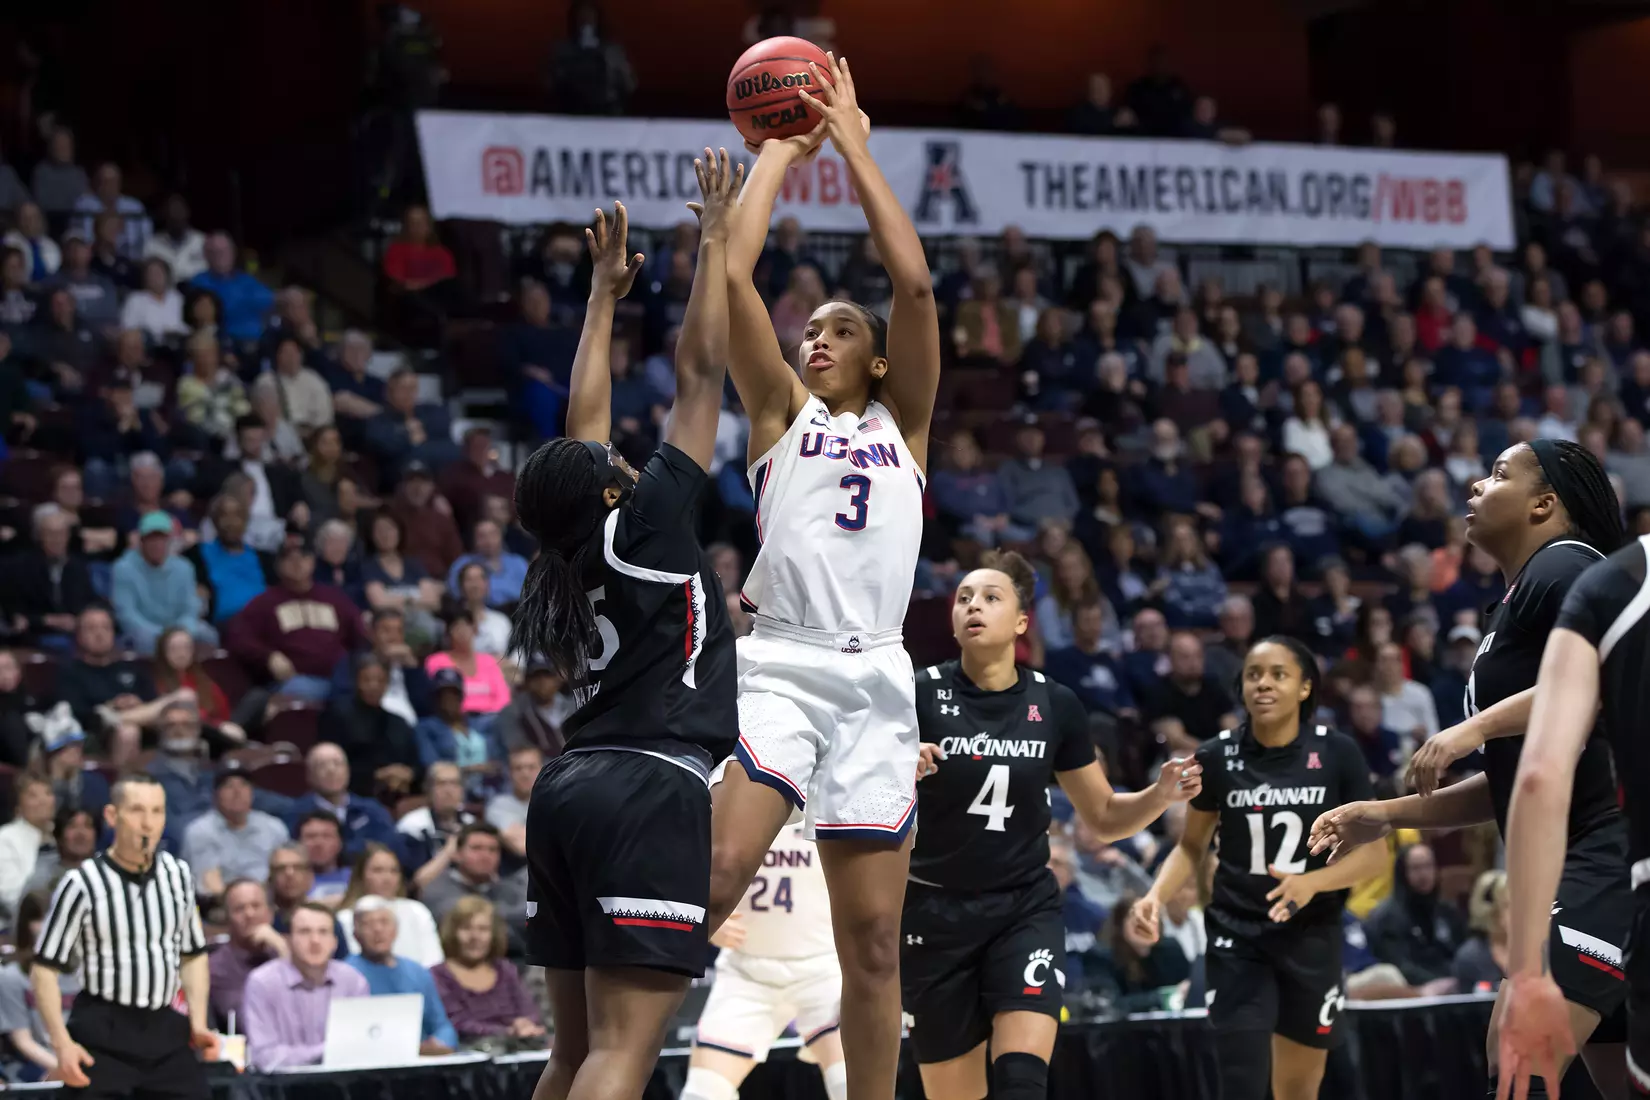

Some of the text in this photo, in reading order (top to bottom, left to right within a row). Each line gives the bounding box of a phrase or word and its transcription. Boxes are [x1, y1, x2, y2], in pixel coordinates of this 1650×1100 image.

[735, 71, 812, 101] Wilson
[751, 103, 809, 130] NCAA
[834, 473, 872, 532] 3
[937, 689, 953, 700] RJ
[939, 734, 1046, 759] CINCINNATI
[1224, 744, 1240, 757] RJ
[966, 764, 1015, 832] 4
[1226, 785, 1327, 808] CINCINNATI
[1245, 811, 1307, 875] 12
[763, 850, 812, 868] ONN
[751, 876, 793, 913] 24
